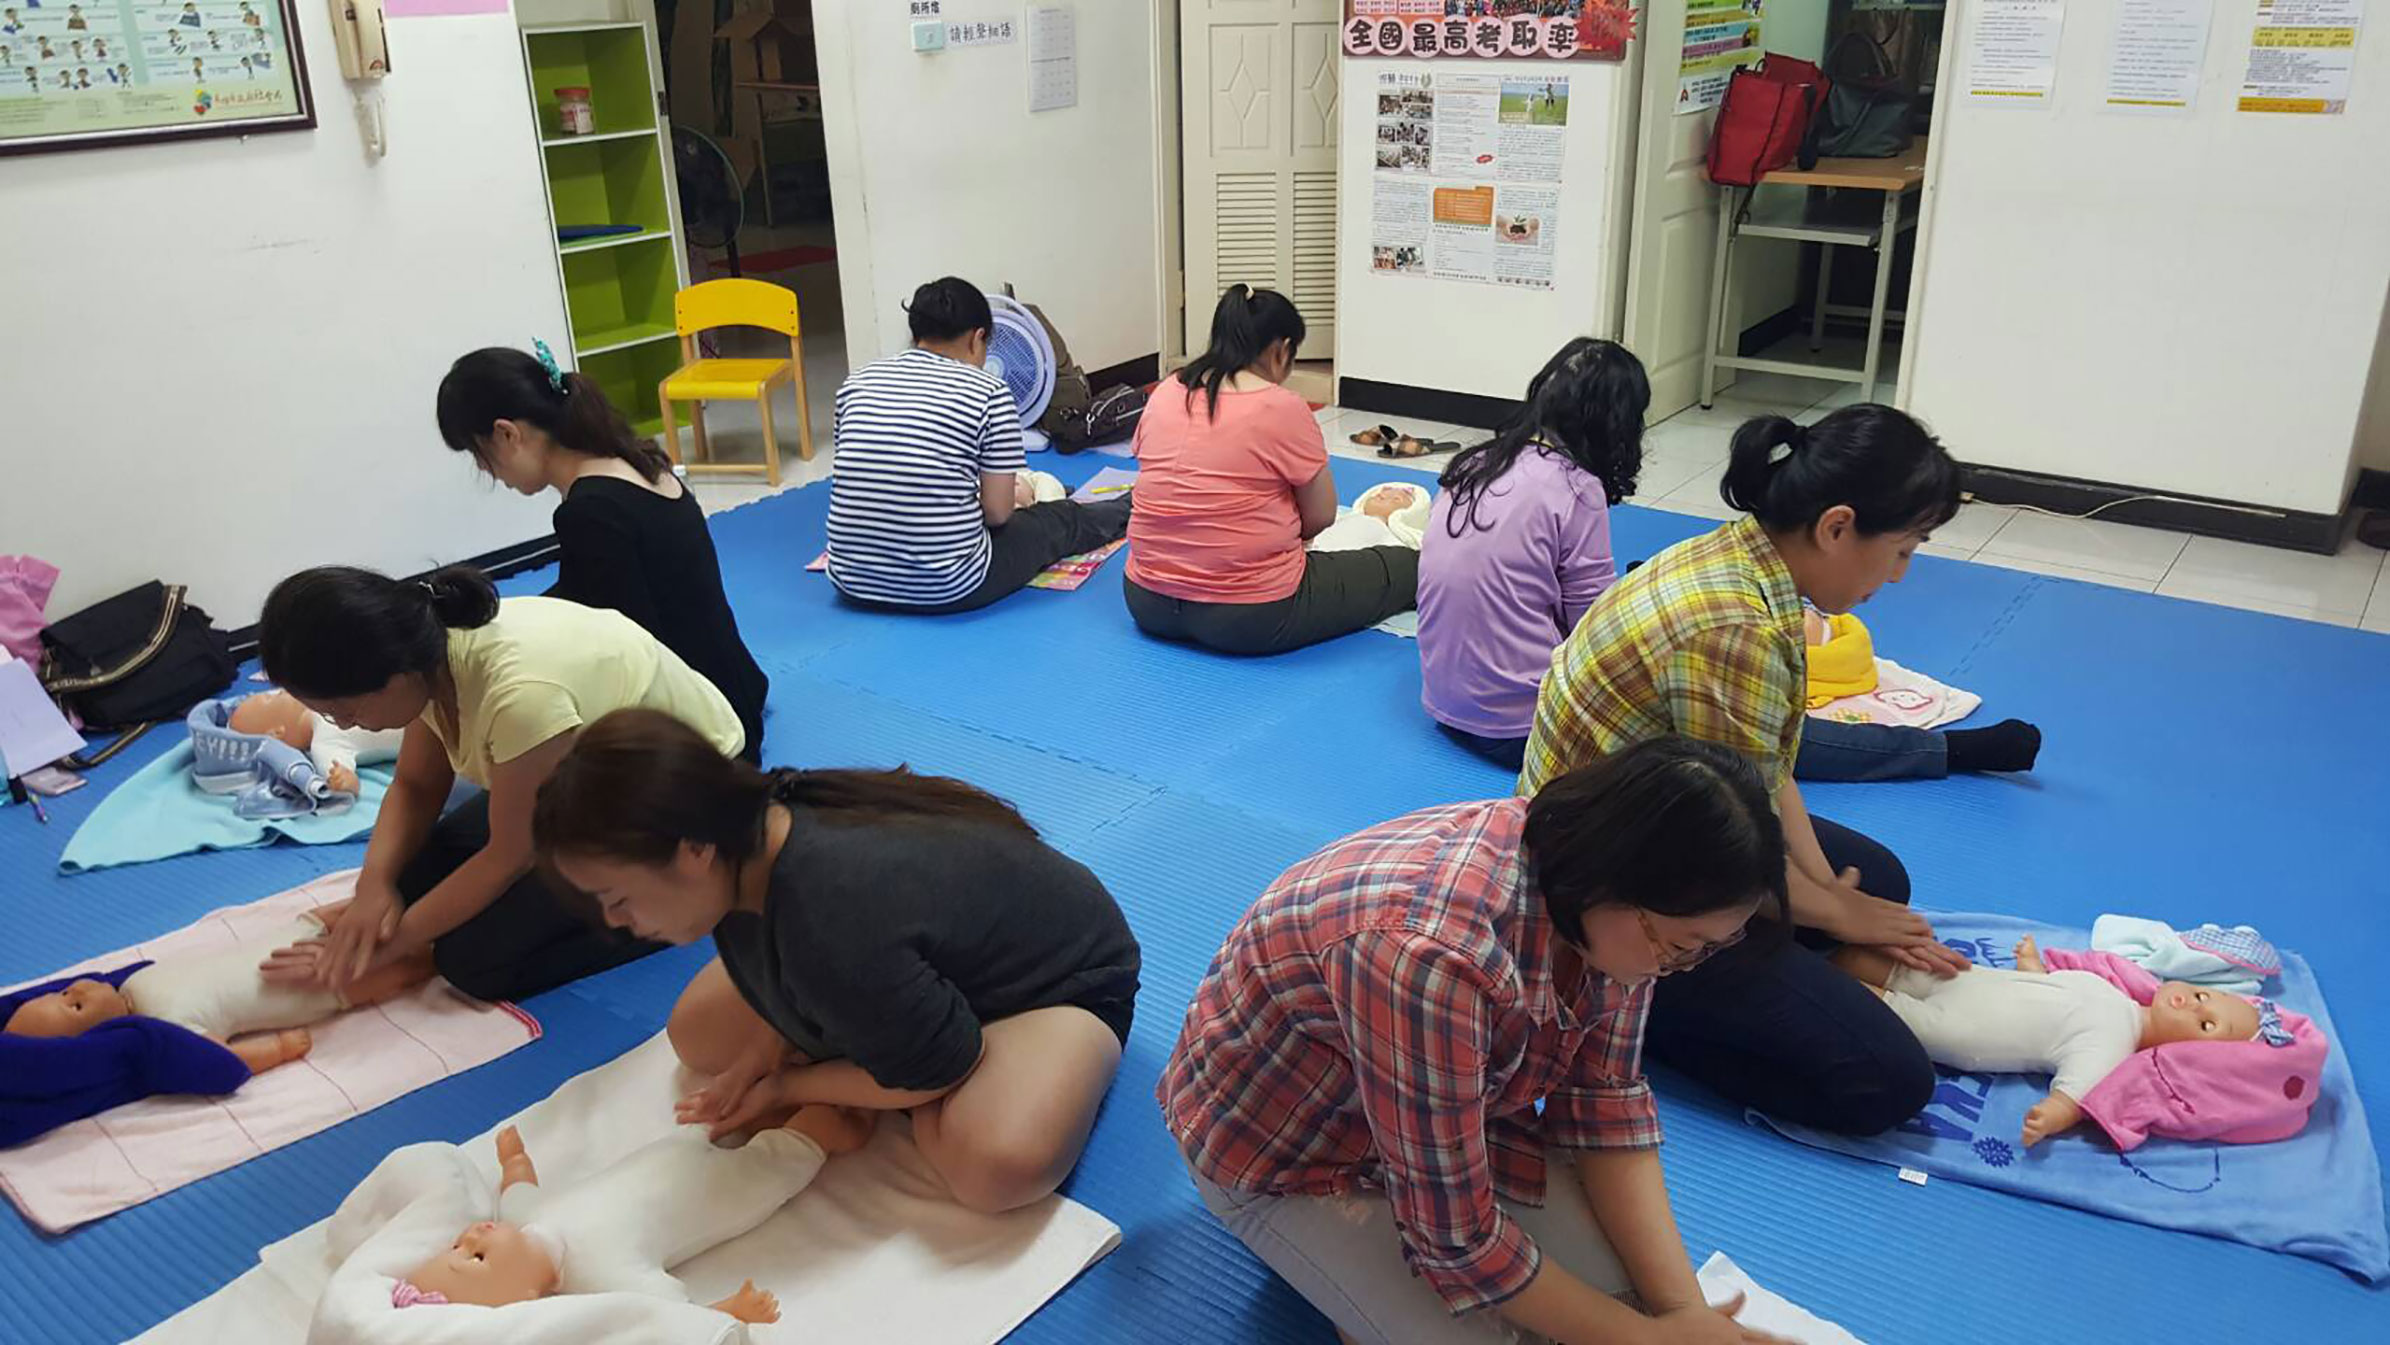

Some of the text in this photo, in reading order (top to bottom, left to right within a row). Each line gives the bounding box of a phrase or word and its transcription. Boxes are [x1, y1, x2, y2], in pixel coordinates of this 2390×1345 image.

[950, 22, 1011, 43] 請輕聲細語
[1350, 17, 1574, 53] 全國最高考取率
